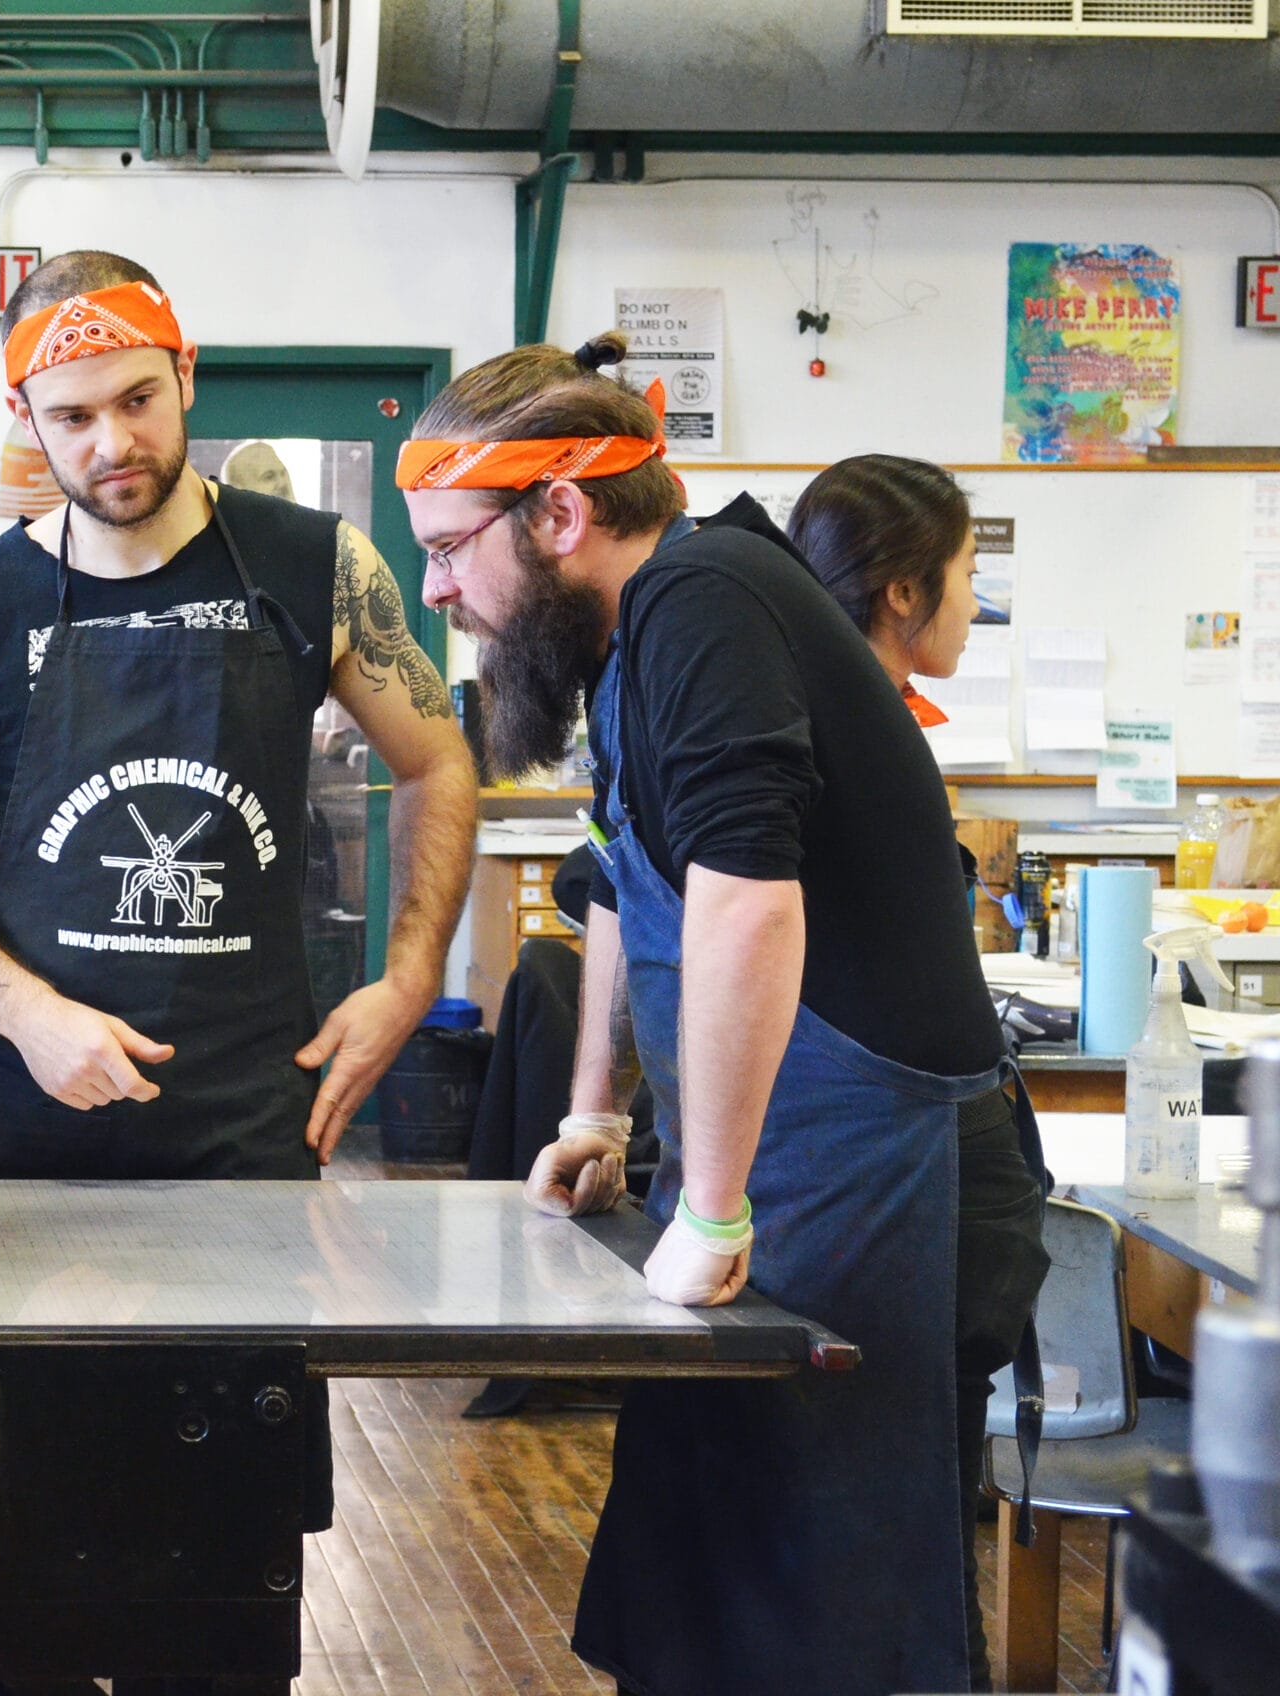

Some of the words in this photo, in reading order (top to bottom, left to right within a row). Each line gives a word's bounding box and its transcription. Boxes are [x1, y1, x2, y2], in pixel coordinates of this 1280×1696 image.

[1256, 264, 1280, 322] E
[619, 303, 639, 314] DO
[642, 303, 670, 314] NOT
[1024, 296, 1087, 320] MIKE
[1097, 296, 1175, 319] PERRY
[619, 319, 660, 330] CLIMB
[634, 335, 680, 346] ALLS
[982, 525, 1008, 536] NOW
[38, 774, 111, 864] GRAPHIC
[110, 757, 229, 798] CHEMICAL
[226, 784, 244, 808] &
[239, 792, 268, 836] INK
[58, 928, 252, 954] www.graphicchemical.com
[1168, 1099, 1201, 1117] WA
